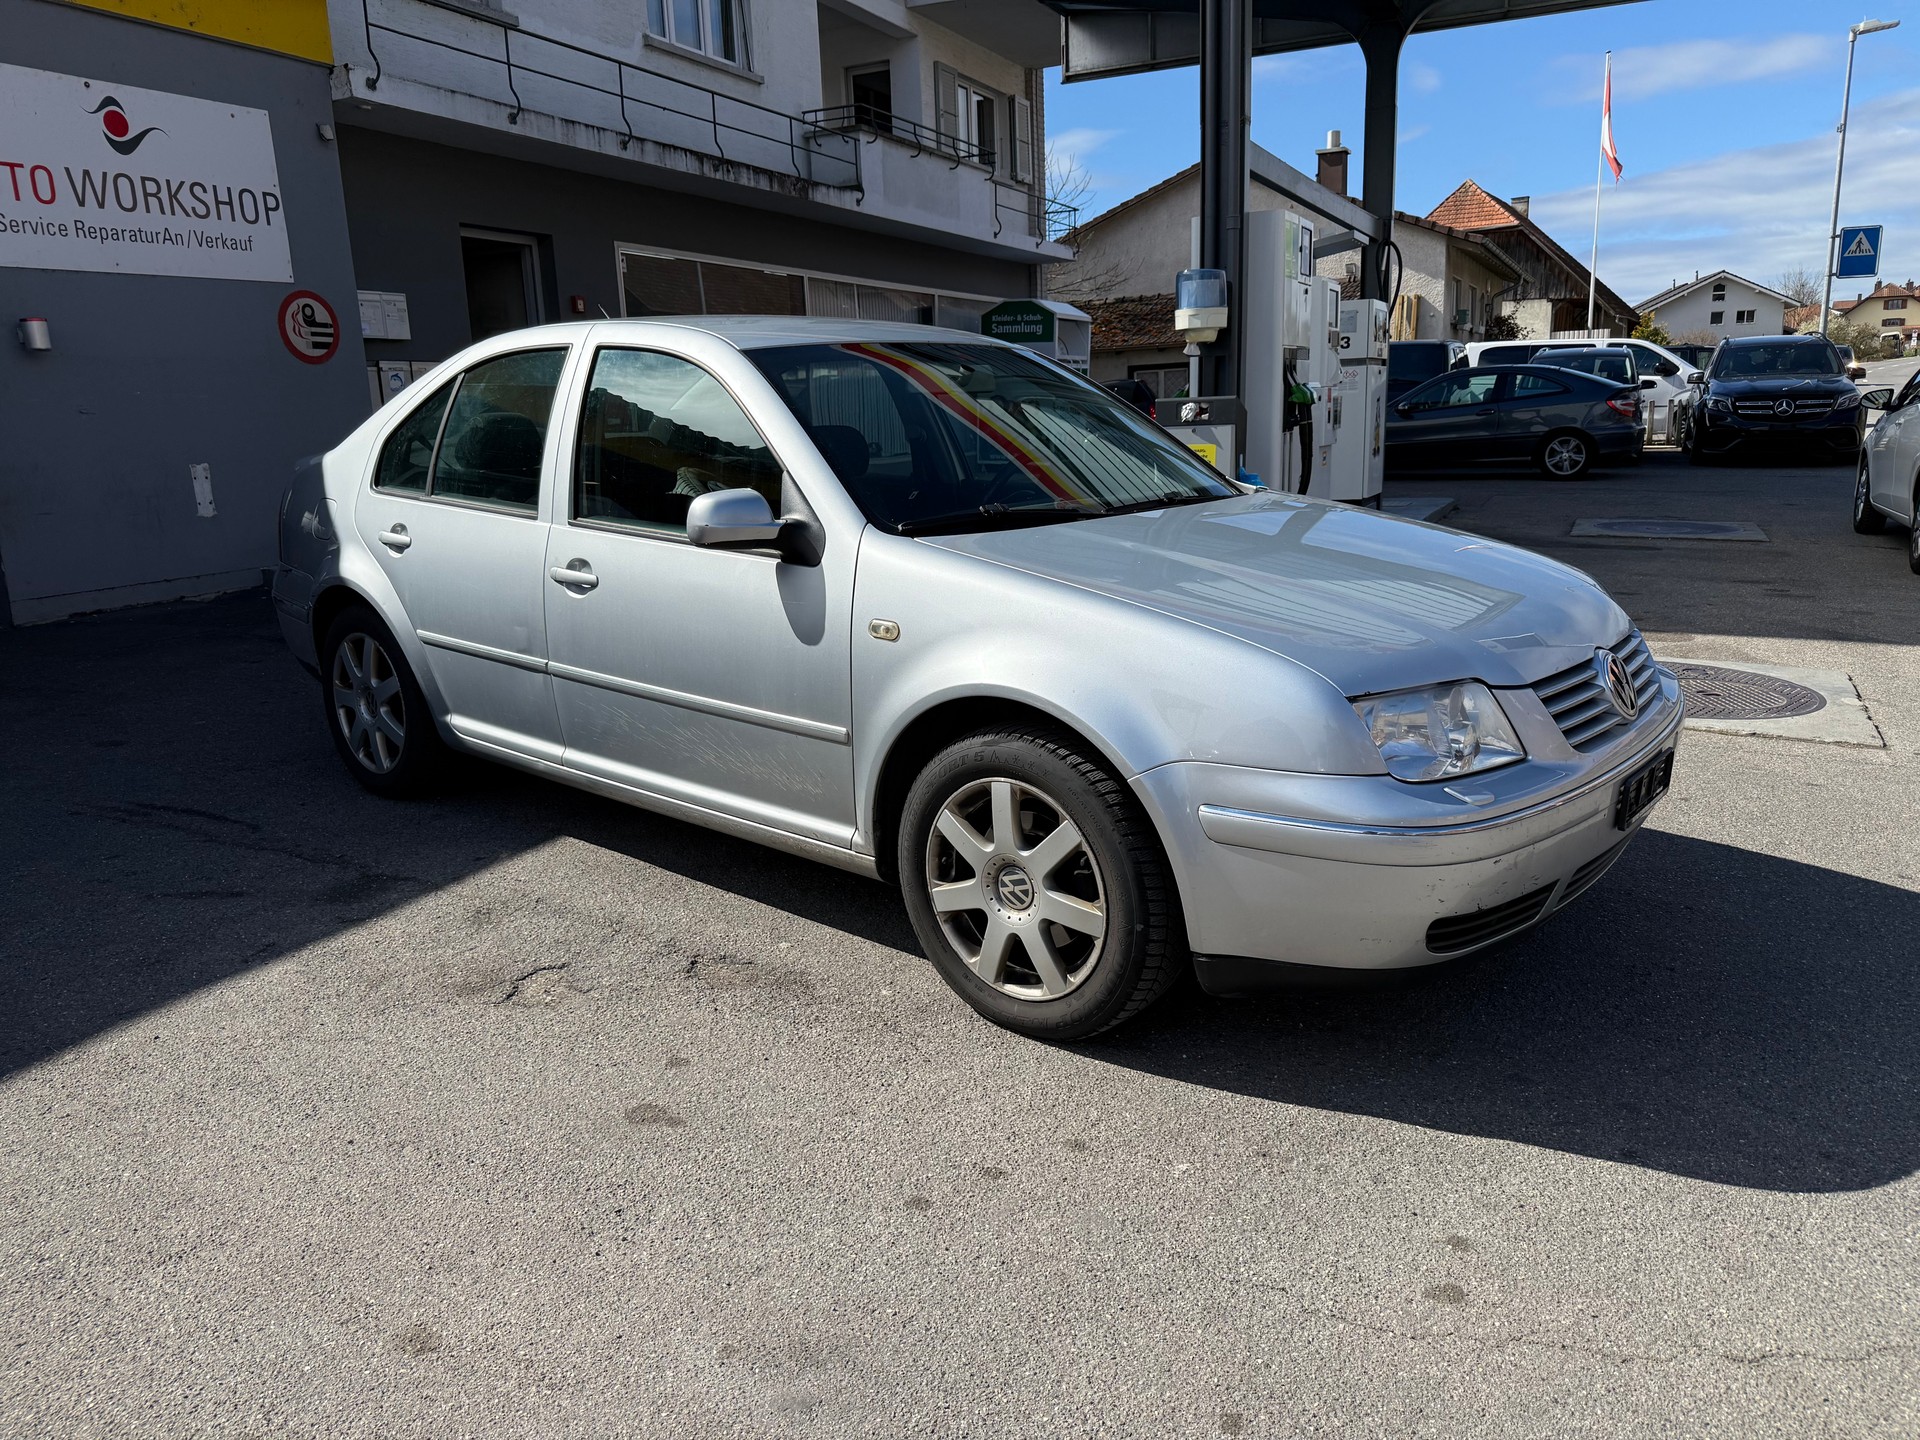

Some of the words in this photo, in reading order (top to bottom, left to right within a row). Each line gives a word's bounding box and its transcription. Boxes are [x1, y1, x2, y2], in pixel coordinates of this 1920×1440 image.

[0, 161, 56, 205] TO
[63, 166, 280, 226] WORKSHOP
[0, 212, 69, 238] Service
[992, 314, 1016, 322] Kleider-
[1023, 313, 1043, 321] Schuh-
[992, 322, 1043, 335] Sammlung
[1340, 336, 1351, 349] 3
